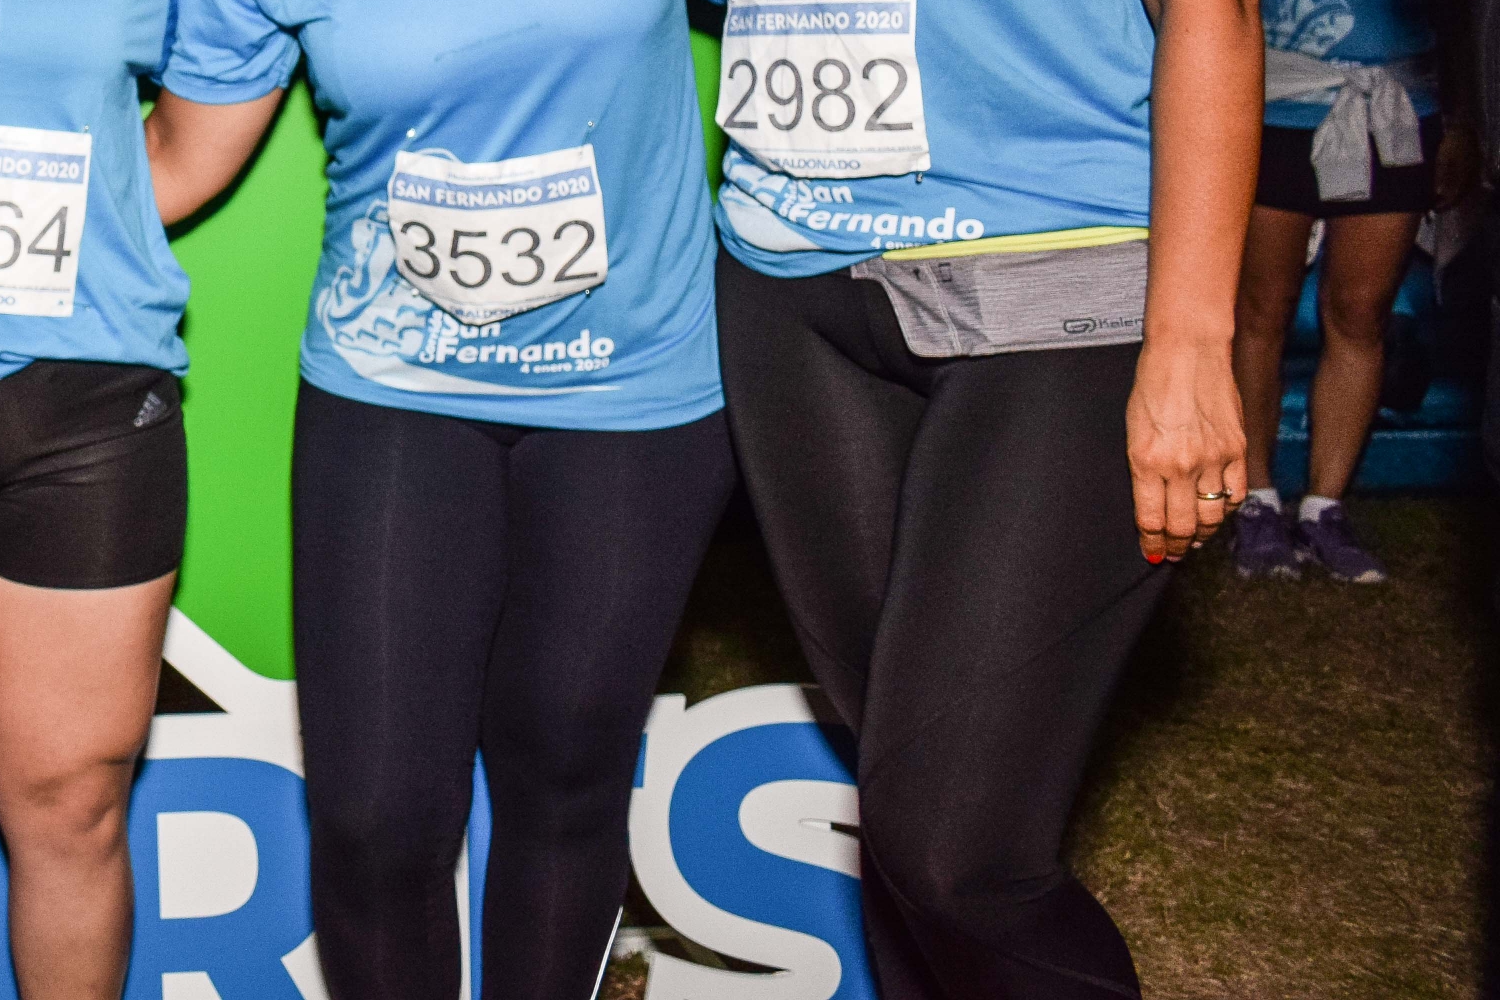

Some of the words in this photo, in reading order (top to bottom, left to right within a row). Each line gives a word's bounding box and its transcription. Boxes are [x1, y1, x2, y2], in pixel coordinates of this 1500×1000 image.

[730, 13, 752, 33] SAN
[756, 12, 850, 31] FERNANDO
[855, 11, 903, 30] 2020
[723, 58, 914, 133] 2982
[36, 160, 80, 180] 2020
[395, 180, 431, 202] SAN
[435, 186, 542, 208] FERNANDO
[548, 175, 591, 199] 2020
[787, 207, 985, 240] Fernando
[400, 219, 598, 289] 3532
[870, 236, 882, 250] 4
[435, 329, 615, 364] Fernando
[520, 362, 530, 374] 4
[533, 361, 572, 374] enero
[574, 357, 610, 372] 2020
